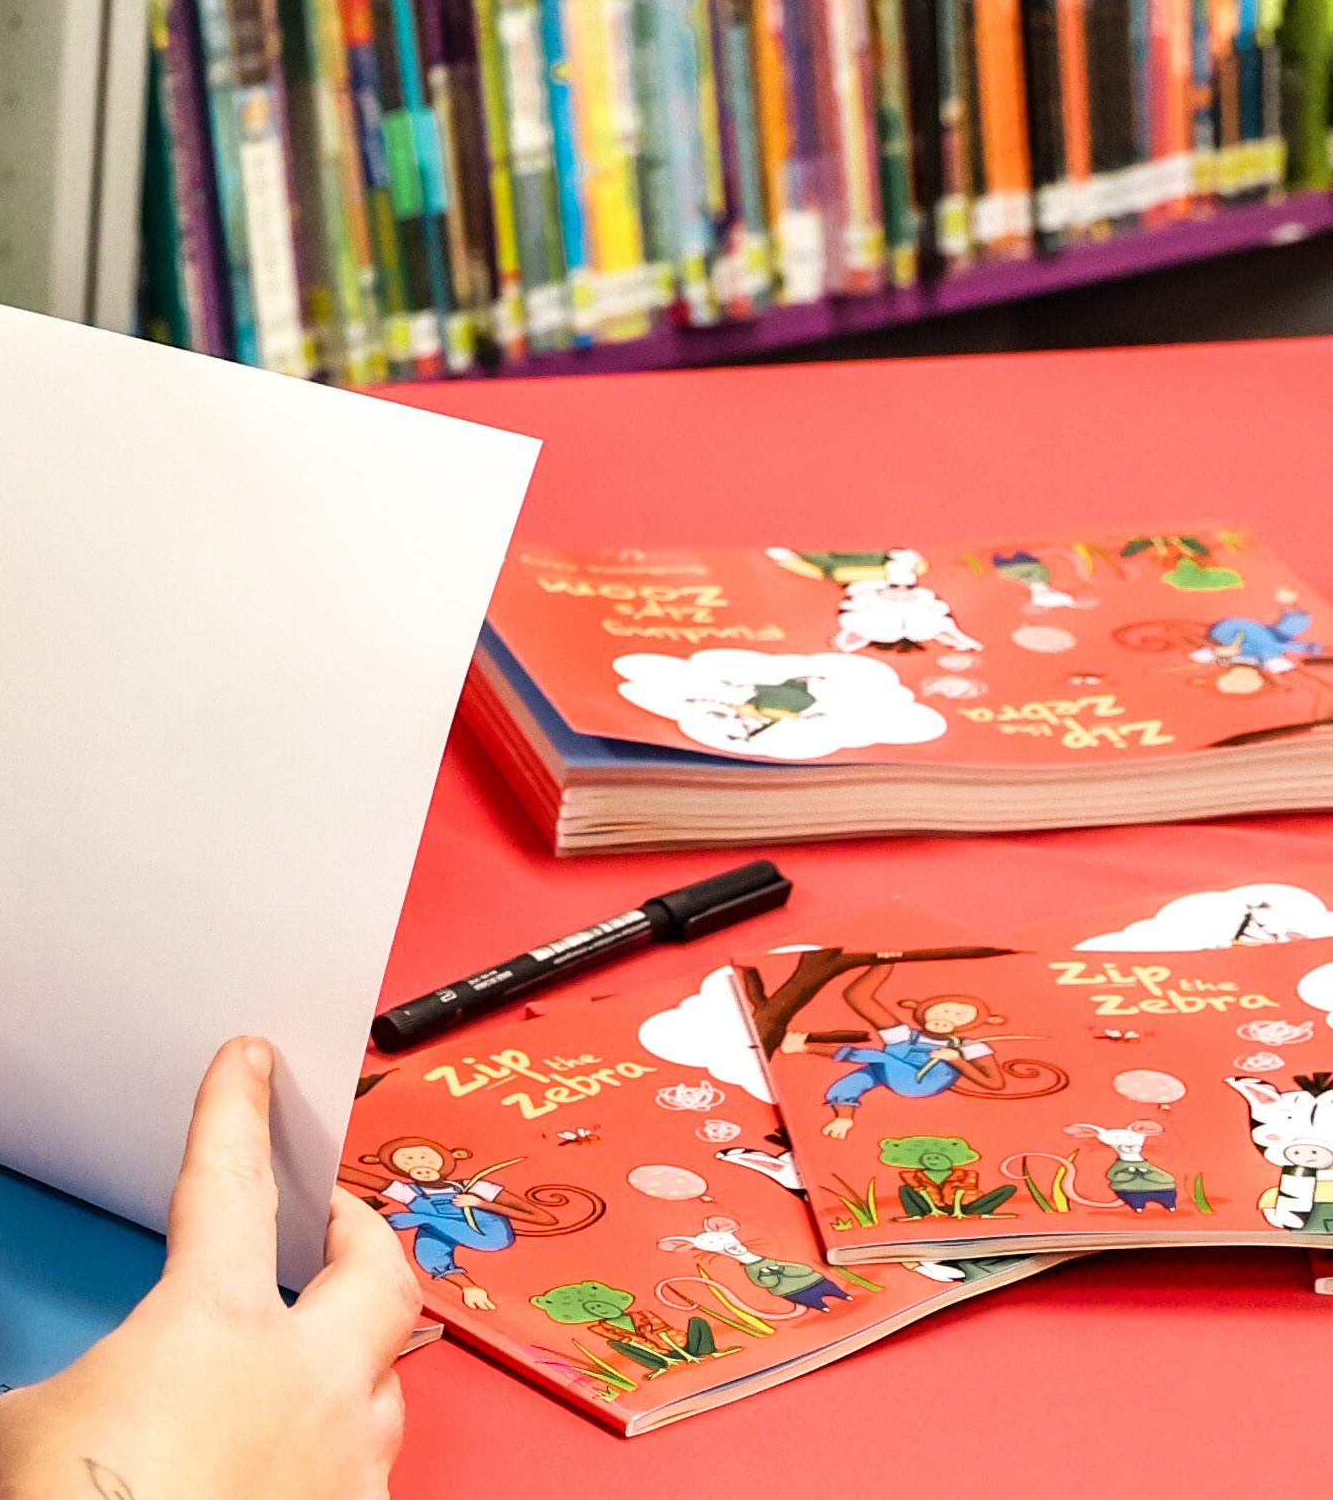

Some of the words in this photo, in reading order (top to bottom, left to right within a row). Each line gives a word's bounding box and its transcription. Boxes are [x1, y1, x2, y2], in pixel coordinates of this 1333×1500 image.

[537, 577, 729, 607] Zoom
[601, 617, 786, 644] Finding
[957, 694, 1126, 725] Zebra
[1060, 716, 1176, 749] Zip
[1048, 960, 1172, 997] Zip
[1178, 977, 1241, 992] the
[1089, 988, 1281, 1016] Zebra
[424, 1049, 551, 1098] Zip
[543, 1053, 603, 1072] the
[500, 1060, 658, 1120] Zebra
